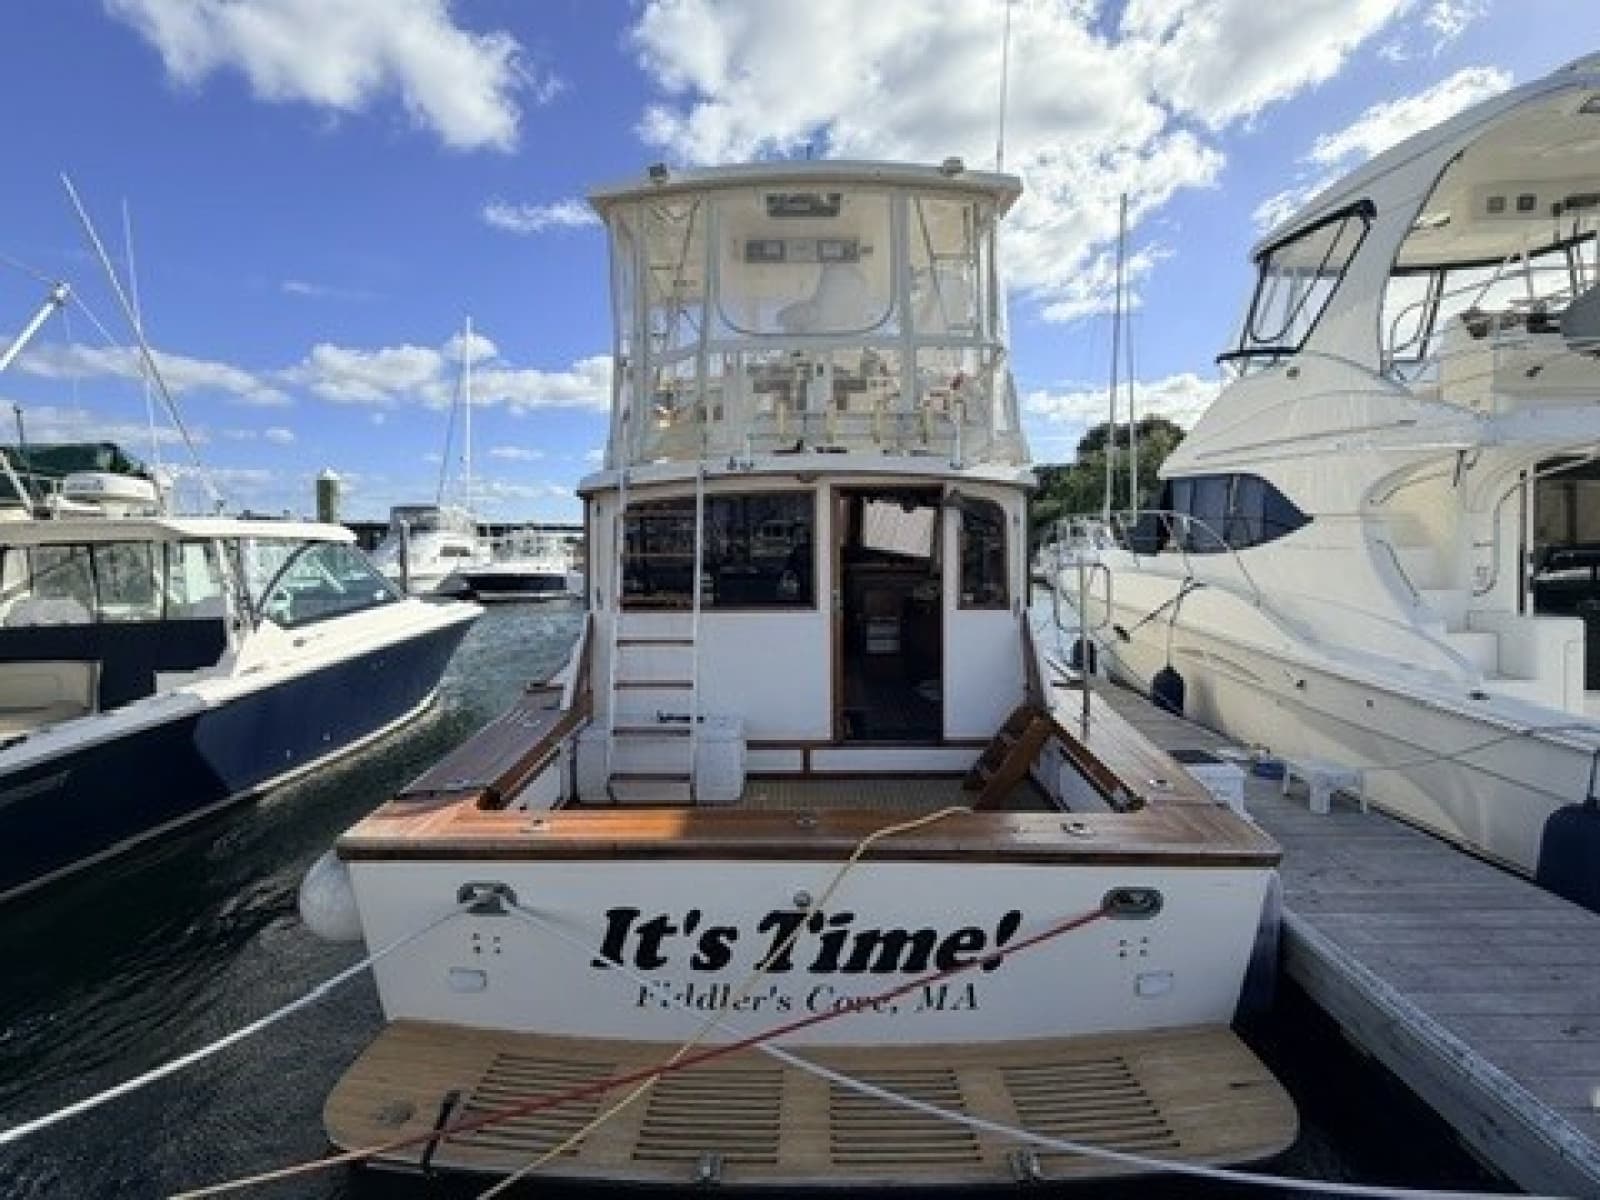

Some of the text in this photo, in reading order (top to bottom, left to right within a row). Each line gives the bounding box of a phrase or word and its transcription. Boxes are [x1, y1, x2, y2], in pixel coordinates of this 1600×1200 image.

[590, 906, 1022, 974] It's Time!
[914, 982, 981, 1012] MA
